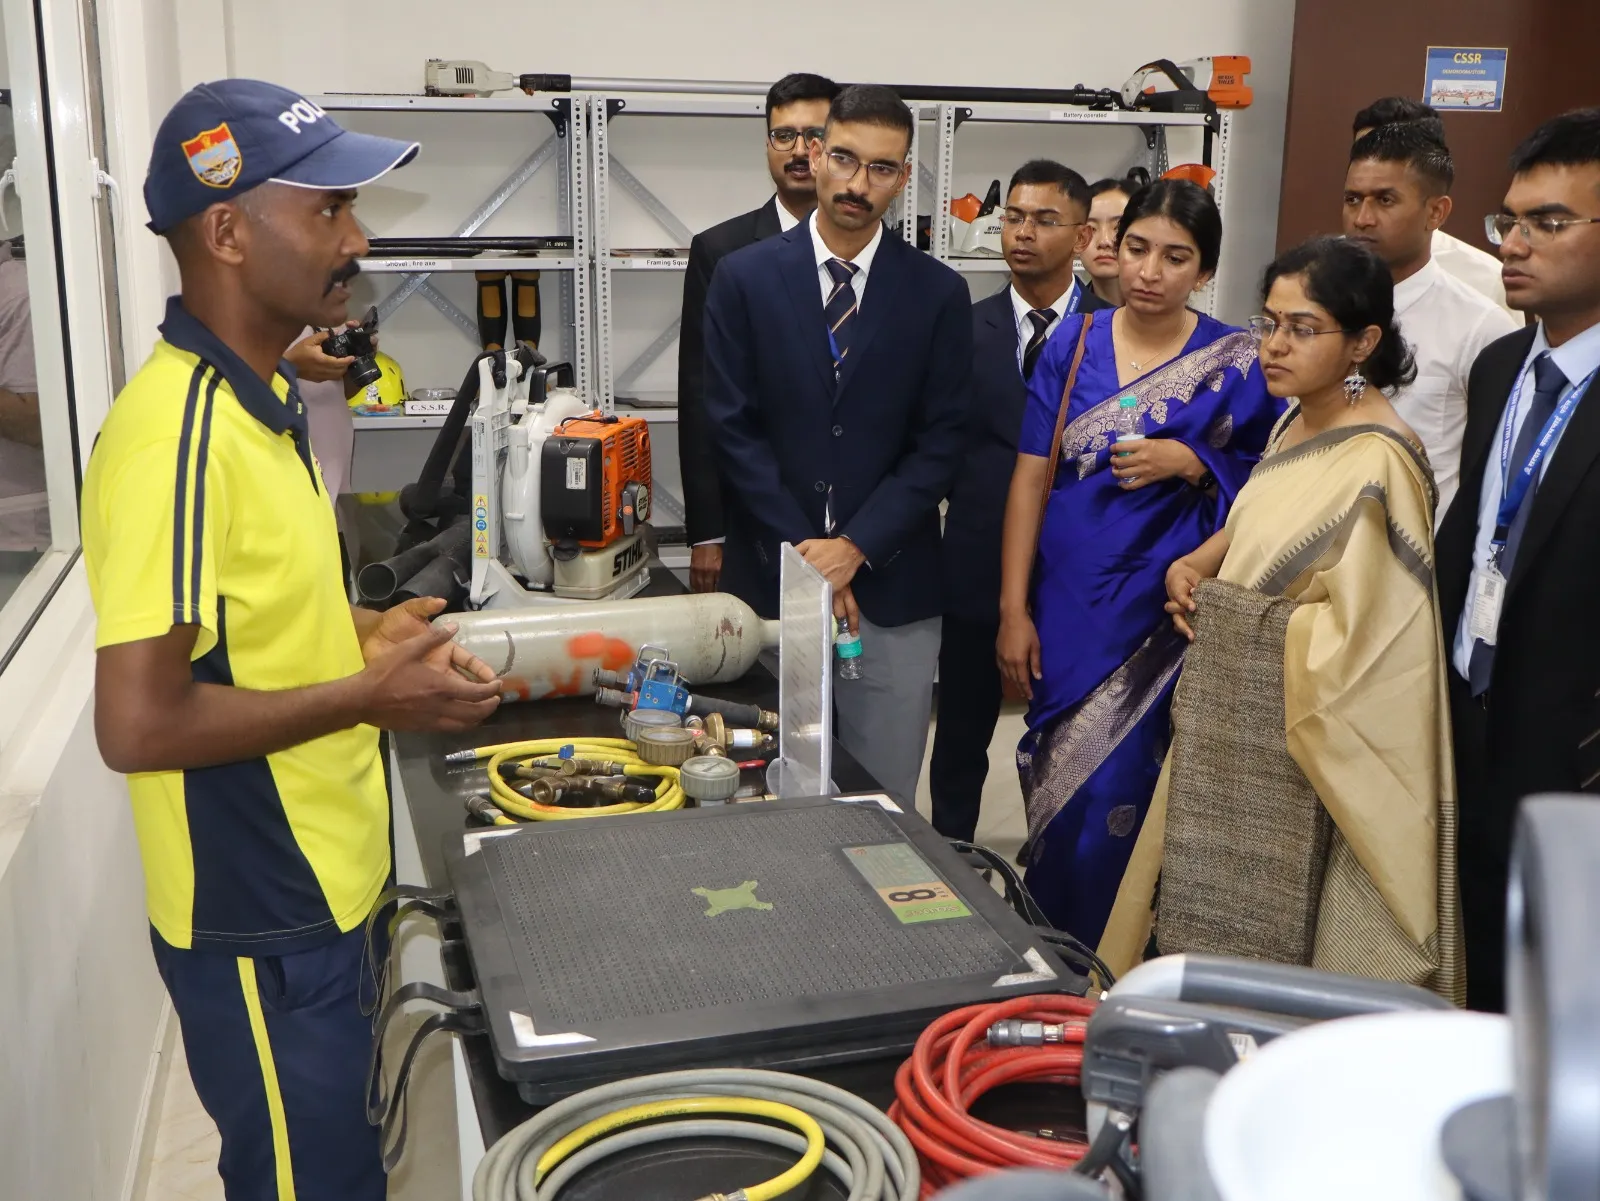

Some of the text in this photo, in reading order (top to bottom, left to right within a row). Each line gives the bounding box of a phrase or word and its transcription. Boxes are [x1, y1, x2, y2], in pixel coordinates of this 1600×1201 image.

[1453, 52, 1482, 64] CSSR
[278, 99, 326, 134] POL
[1063, 112, 1108, 120] Battery operated
[646, 259, 688, 267] Framing Squa
[410, 403, 448, 413] C.S.S.R.
[611, 538, 643, 577] STIHL
